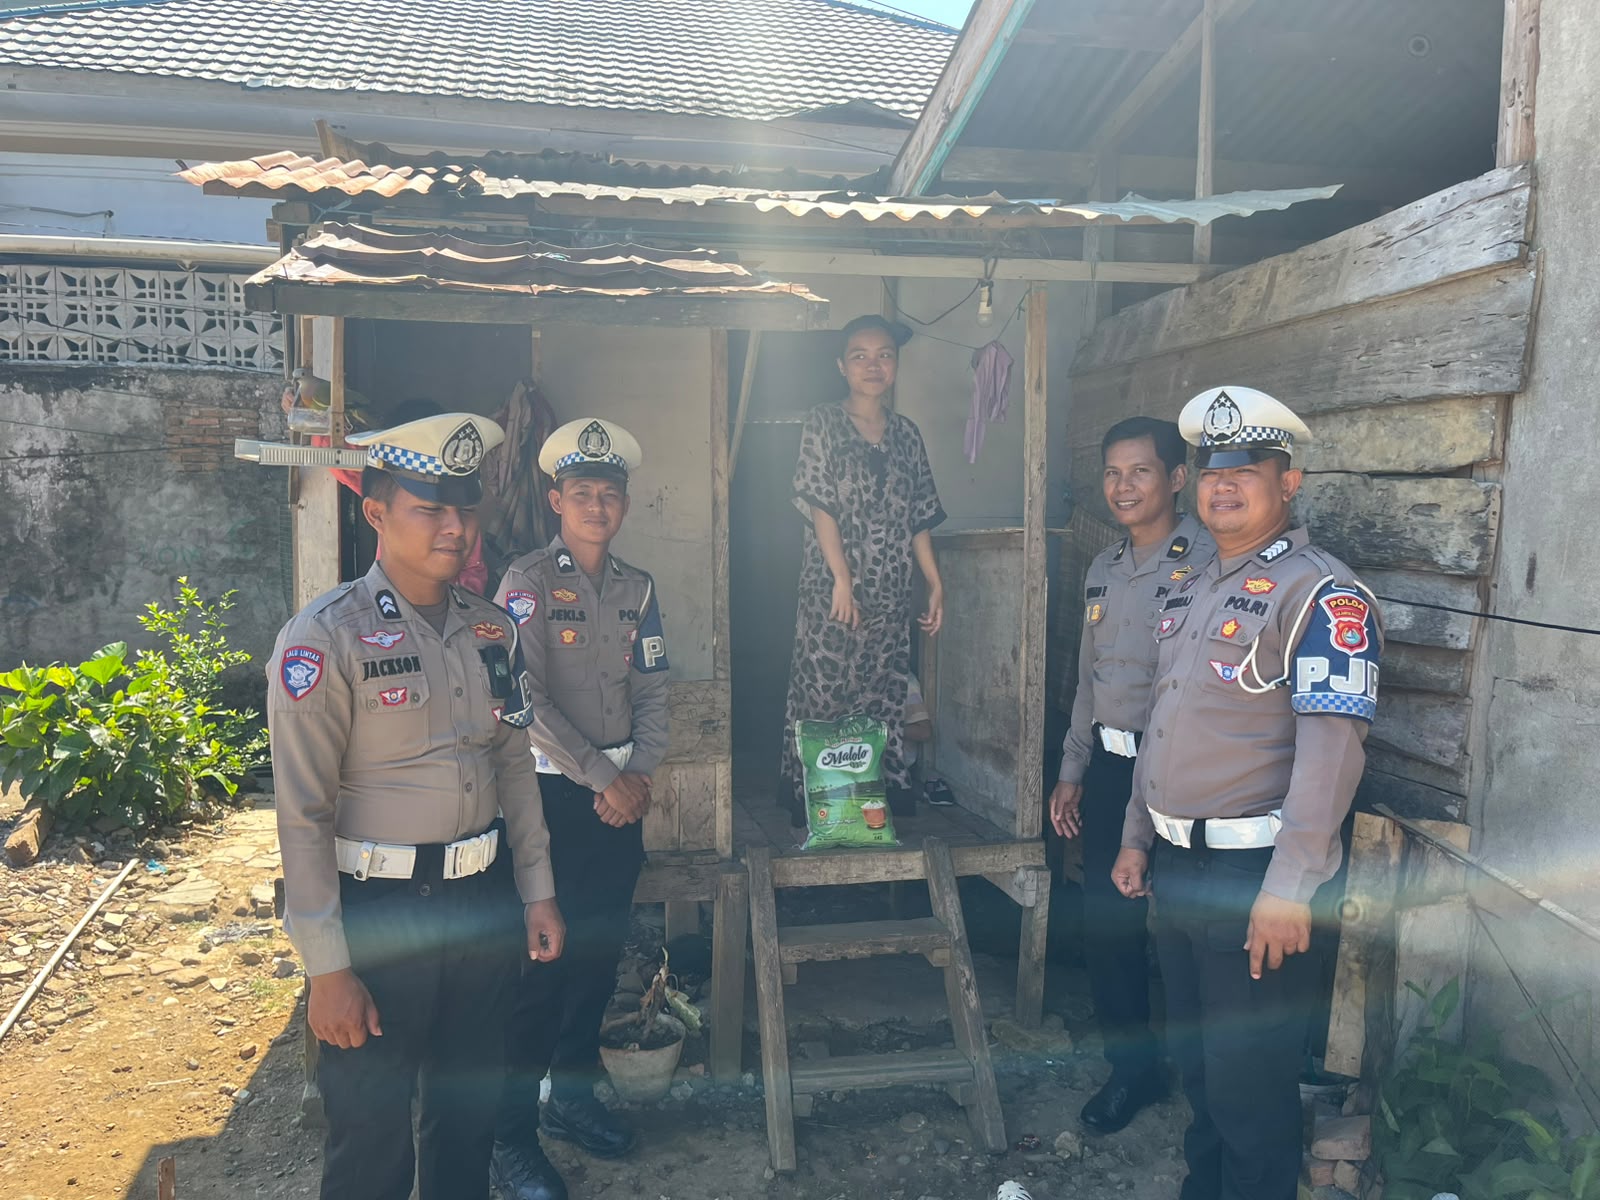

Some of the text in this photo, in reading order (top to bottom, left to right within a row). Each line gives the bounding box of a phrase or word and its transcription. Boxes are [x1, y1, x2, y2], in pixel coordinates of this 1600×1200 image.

[1223, 595, 1269, 617] POLRI
[1329, 598, 1365, 612] POLDA
[286, 649, 320, 662] LALU LINTAS
[642, 635, 664, 668] P
[362, 655, 422, 681] JACKSON
[821, 745, 868, 765] Malolo
